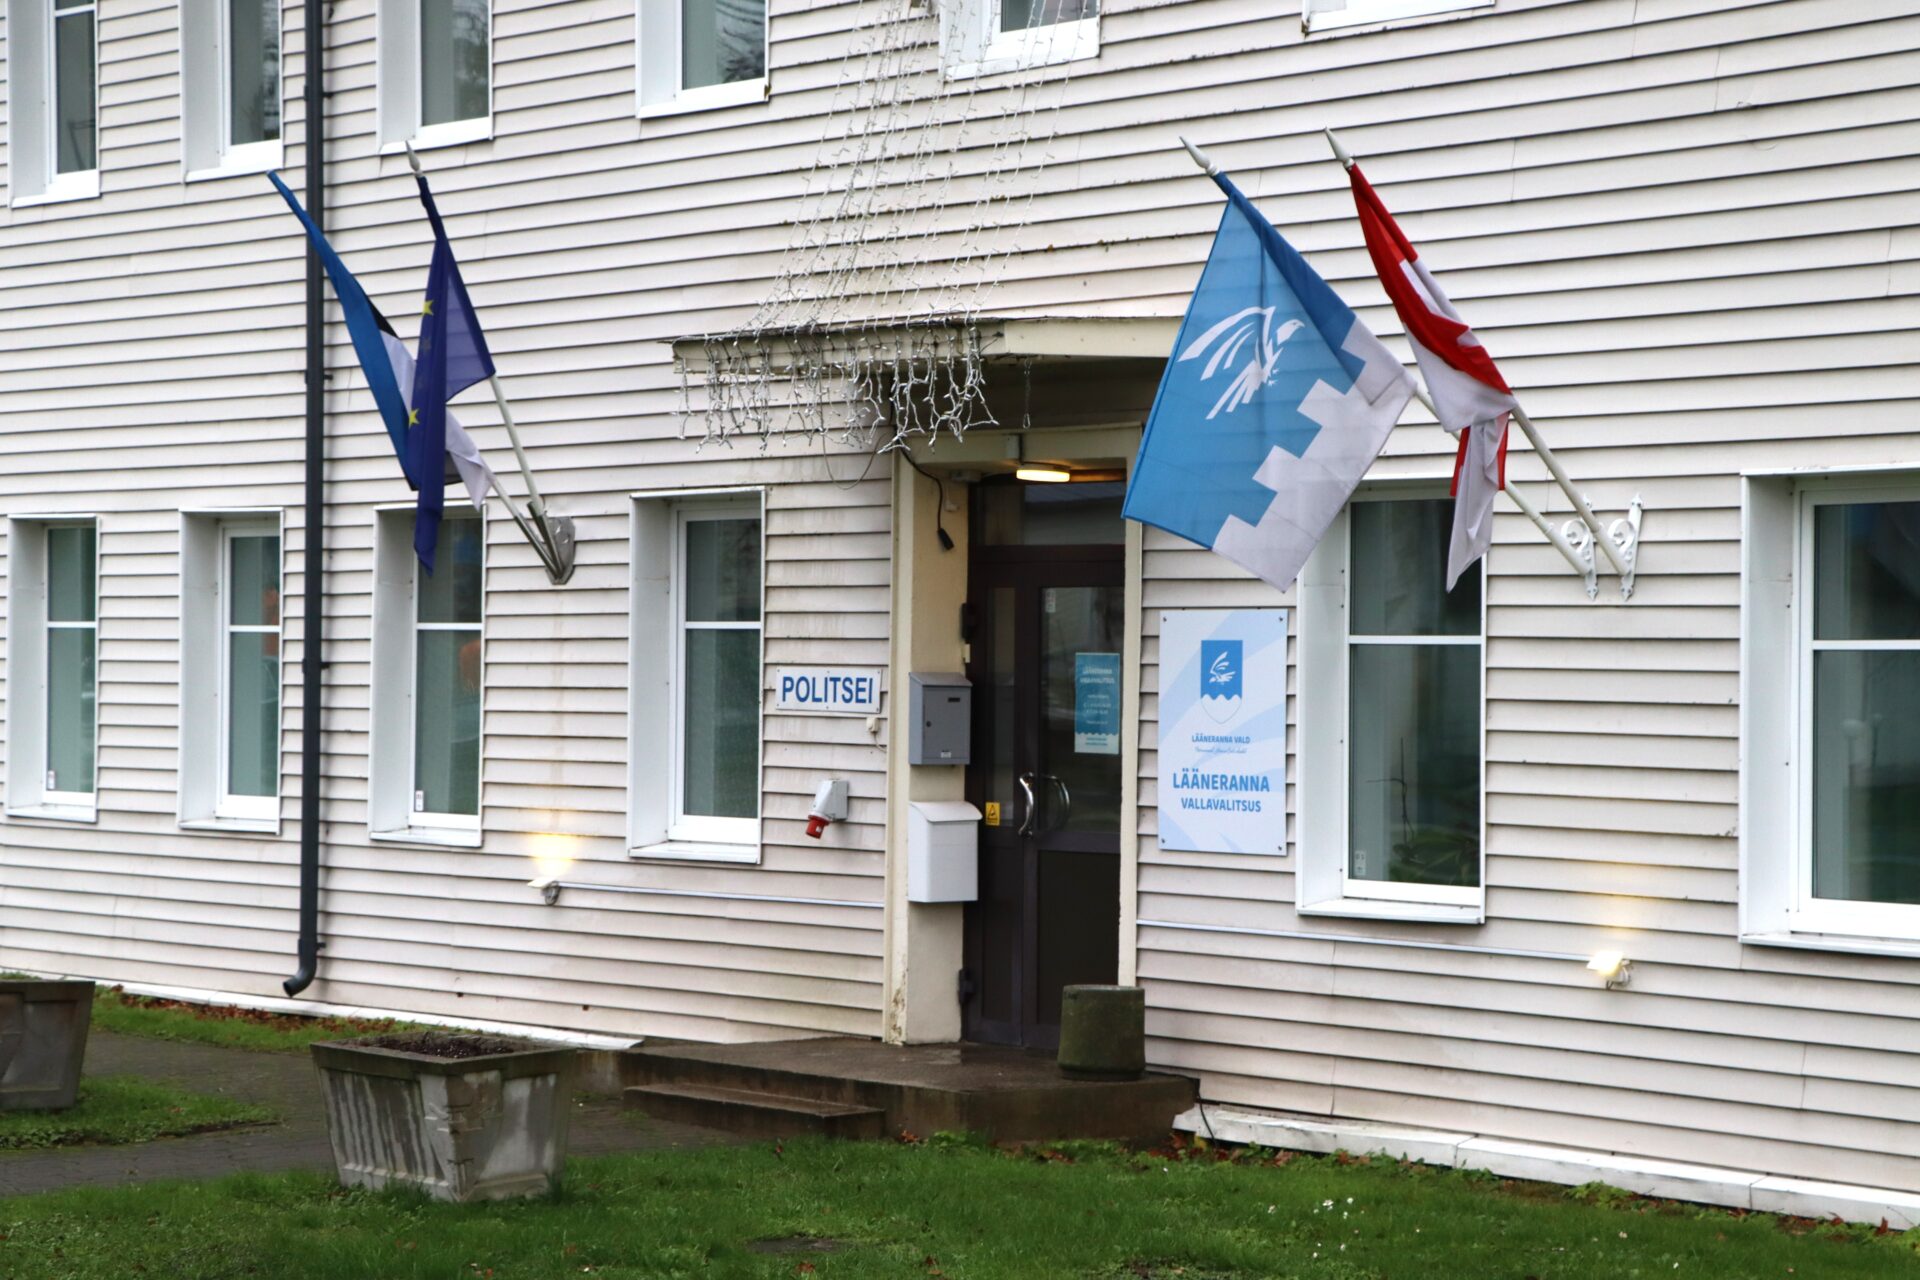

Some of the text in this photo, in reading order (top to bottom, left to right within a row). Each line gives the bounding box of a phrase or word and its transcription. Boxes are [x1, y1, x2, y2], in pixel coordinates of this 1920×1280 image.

[782, 676, 873, 704] POLITSEI
[1191, 732, 1251, 745] LÄÄNERANNA VALD
[1173, 768, 1270, 792] LÄÄNERANNA
[1181, 797, 1262, 812] VALLAVALITSUS
